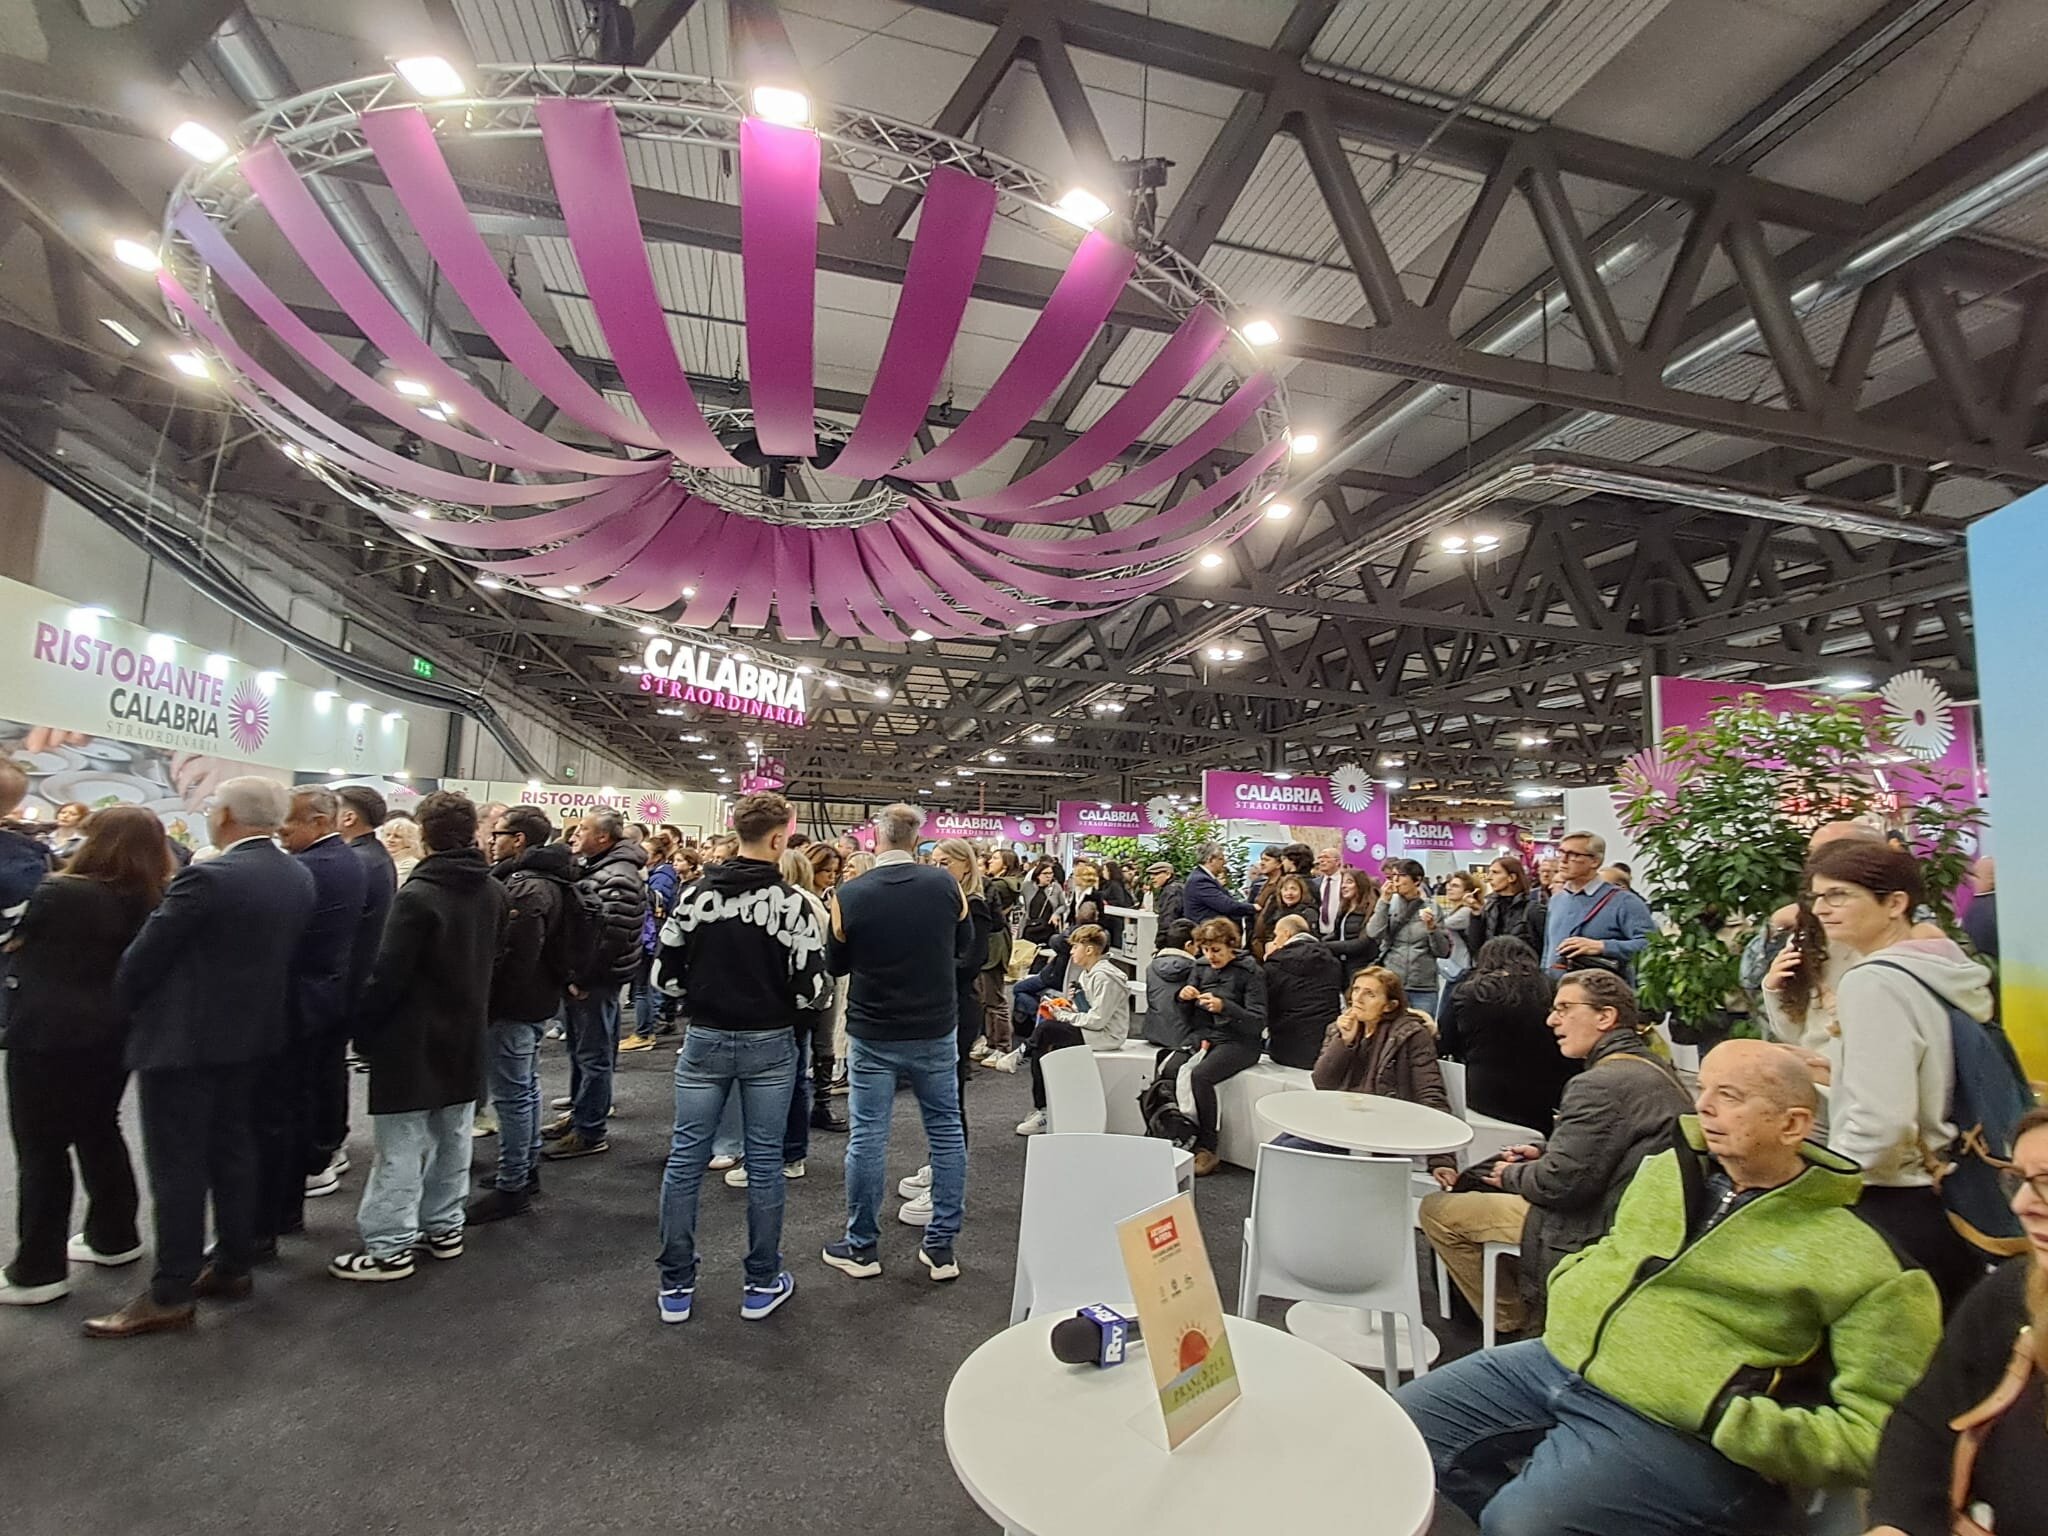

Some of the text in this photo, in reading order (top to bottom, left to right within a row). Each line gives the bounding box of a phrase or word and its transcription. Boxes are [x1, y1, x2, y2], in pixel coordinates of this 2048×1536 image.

[34, 621, 223, 707] RISTORANTE
[644, 638, 806, 712] CALABRIA
[640, 674, 805, 726] STRAORDINARIA
[110, 688, 219, 738] CALABRIA
[521, 791, 631, 809] RISTORANTE
[1235, 783, 1323, 804] CALABRIA
[1079, 809, 1140, 822] CALABRIA
[1235, 802, 1323, 813] STRAORDINARIA
[936, 815, 1003, 830] CALABRIA
